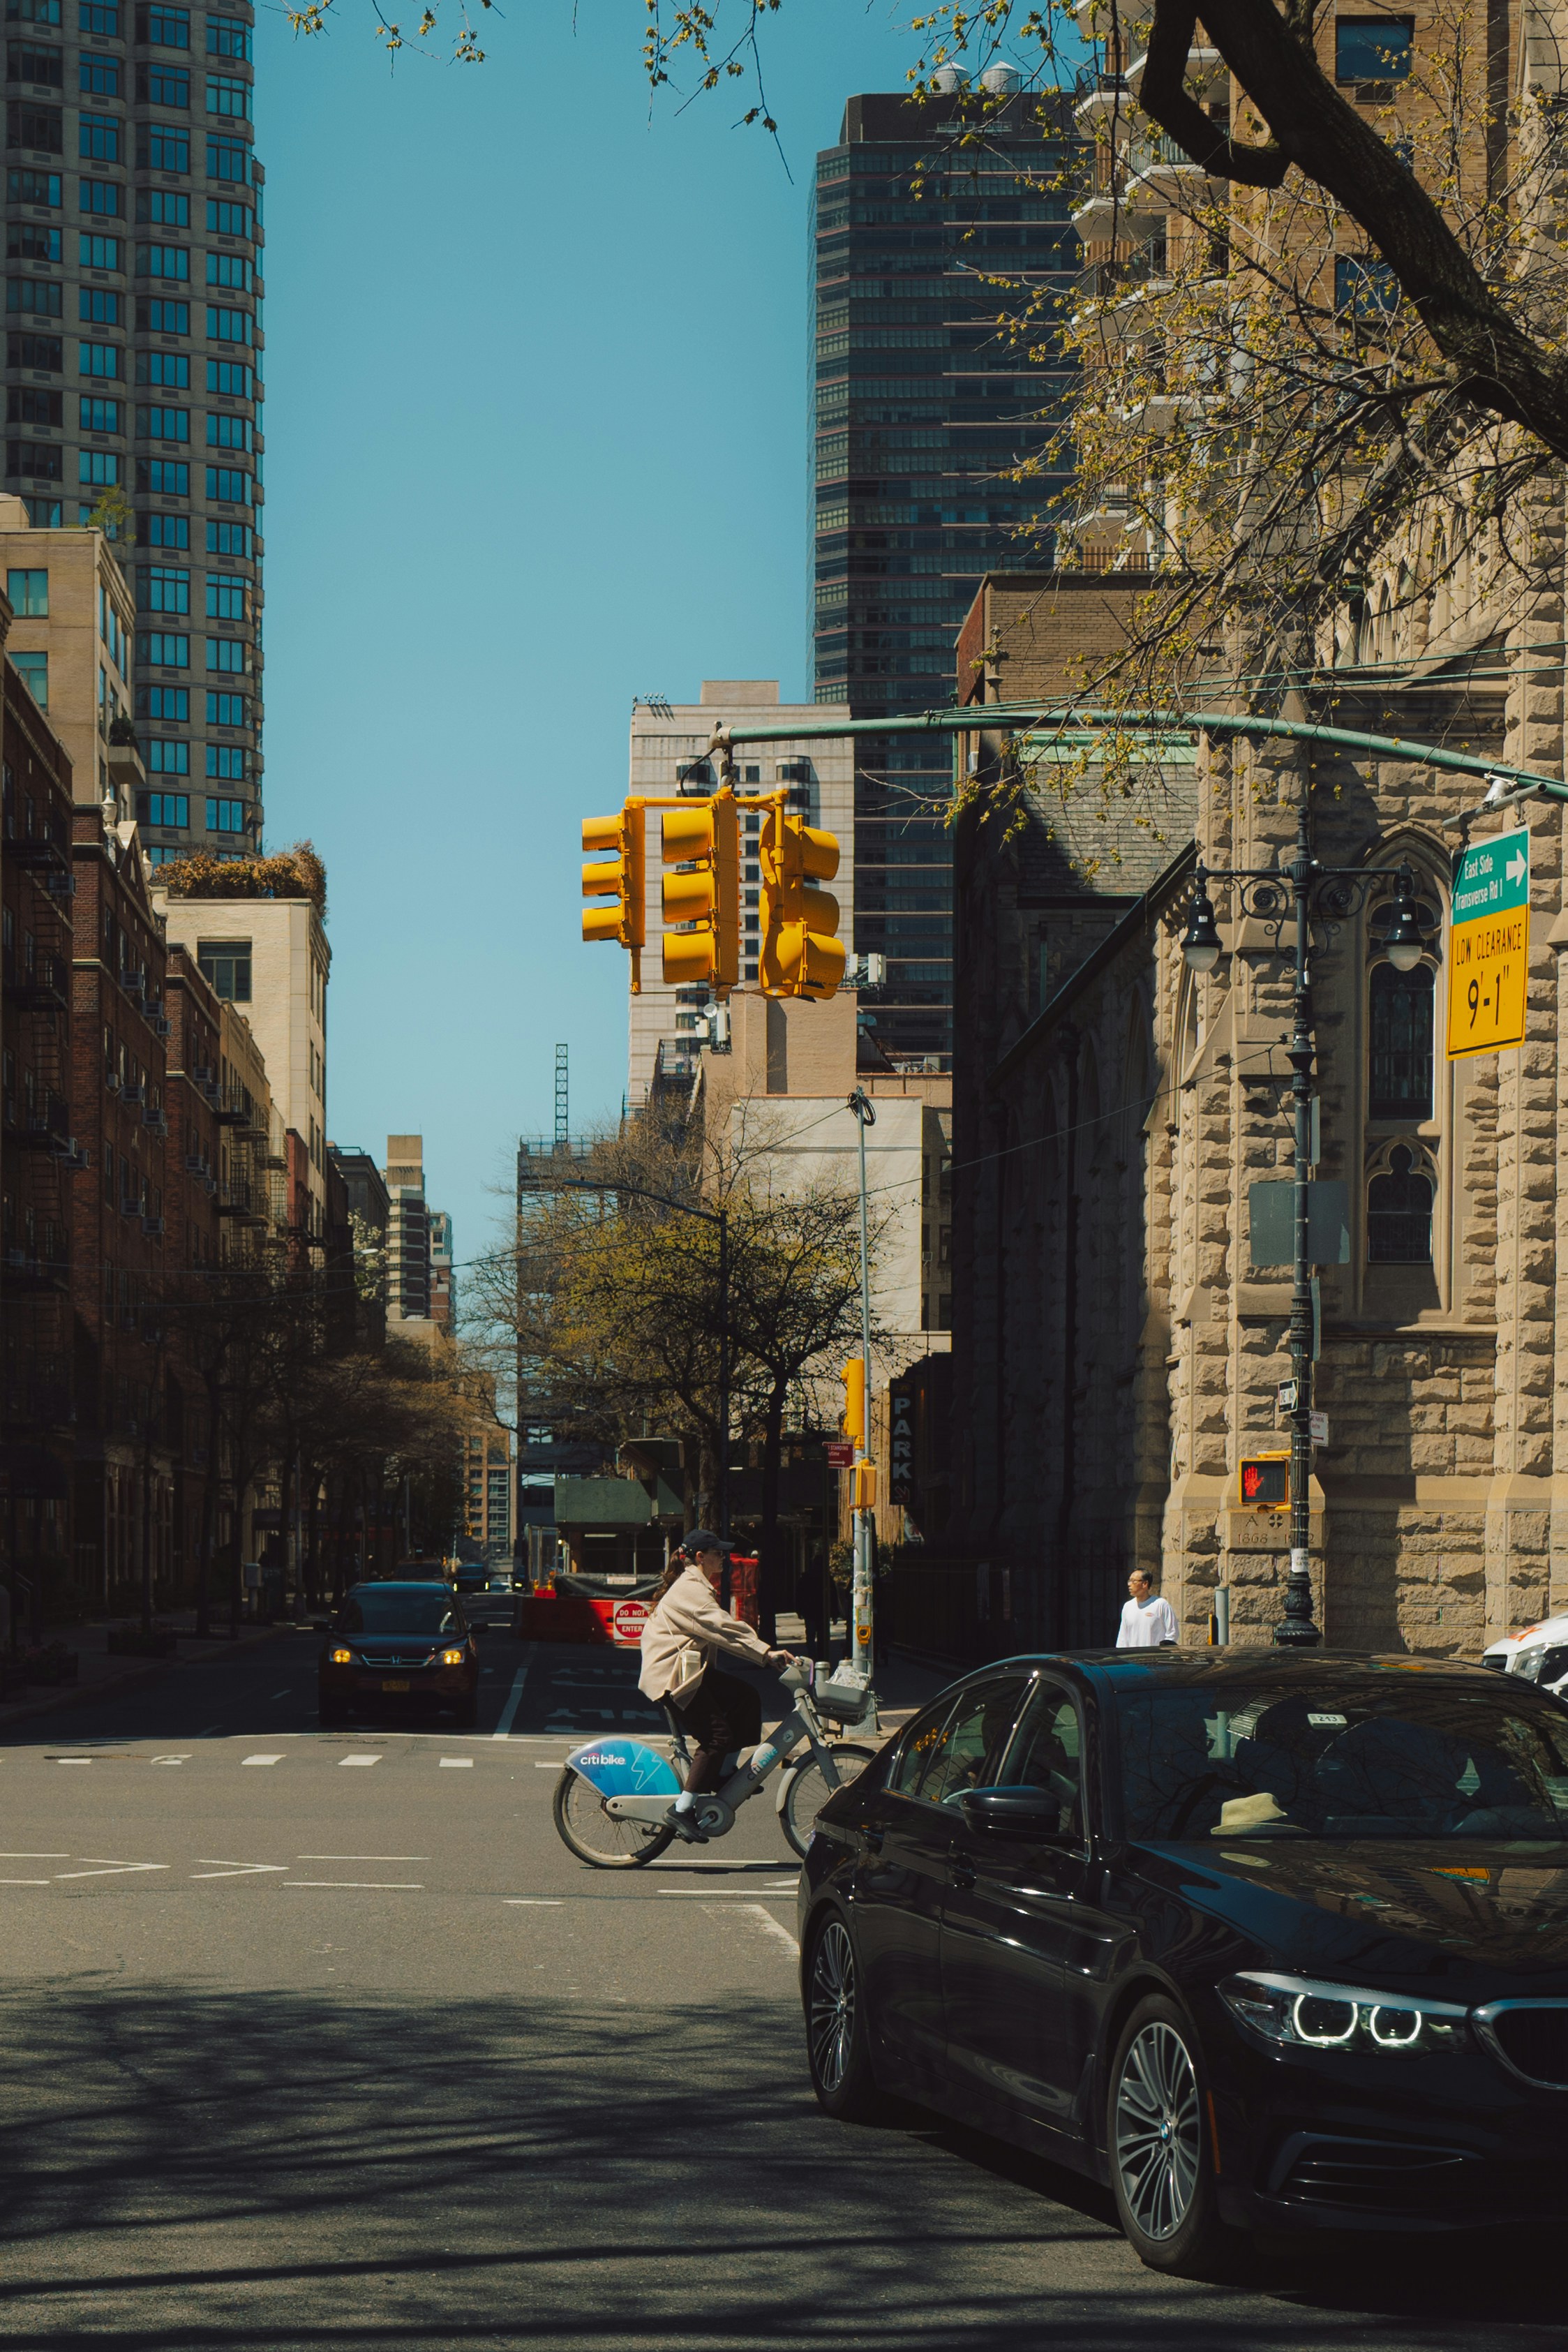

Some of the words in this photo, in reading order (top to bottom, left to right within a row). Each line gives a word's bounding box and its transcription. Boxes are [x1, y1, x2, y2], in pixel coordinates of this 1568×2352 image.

[1465, 858, 1478, 879] East
[1479, 854, 1493, 875] Side
[1455, 887, 1488, 911] Transverse
[1489, 879, 1498, 900] Rd
[1456, 937, 1472, 965] LOW
[1477, 923, 1521, 960] CLEARANCE
[893, 1398, 913, 1479] PARK
[1239, 1533, 1268, 1545] 1868
